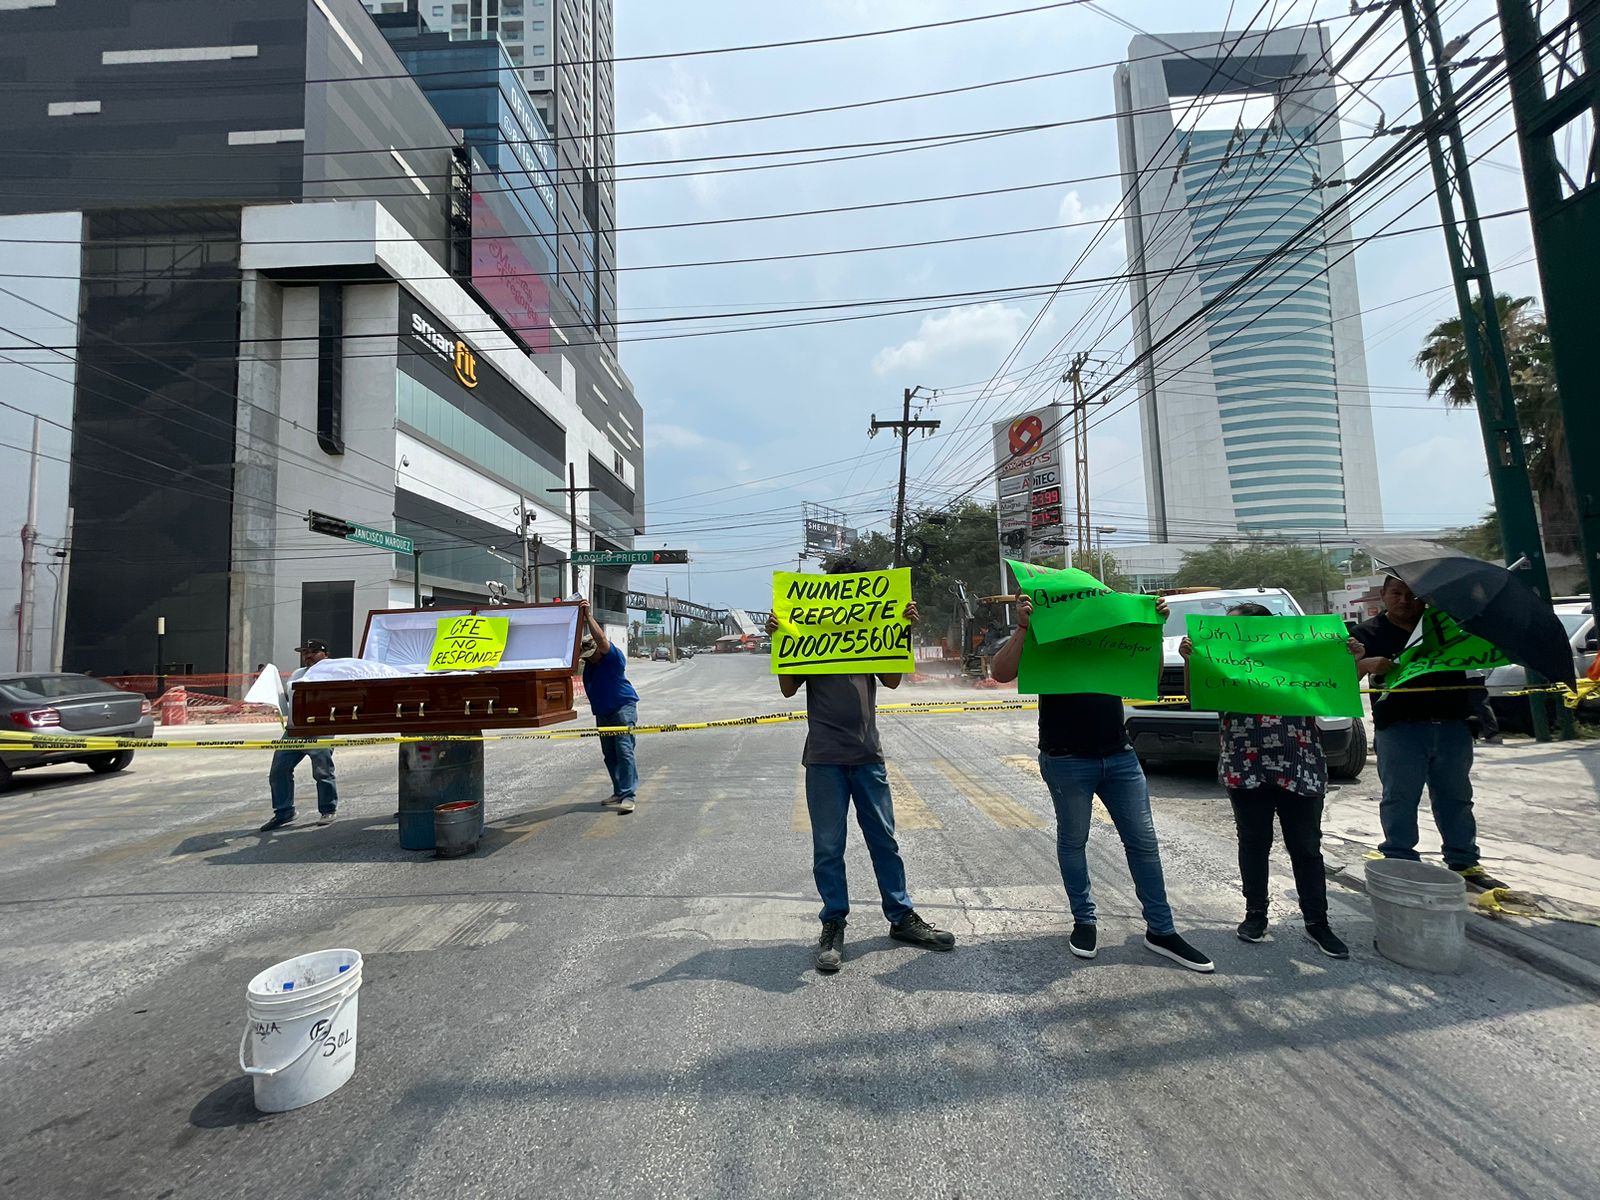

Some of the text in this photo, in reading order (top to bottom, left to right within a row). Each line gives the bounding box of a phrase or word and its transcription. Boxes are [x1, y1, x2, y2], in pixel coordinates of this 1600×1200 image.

[412, 313, 455, 361] smart
[455, 340, 477, 384] fit
[808, 521, 828, 532] SHEIN
[385, 535, 411, 551] MARQUEZ
[577, 553, 648, 562] ADOLFO PRIETO
[786, 575, 890, 601] NUMERO
[788, 599, 898, 626] REPORTE
[450, 618, 486, 636] CFE
[1278, 630, 1305, 642] no
[450, 639, 477, 650] NO
[432, 650, 502, 666] RESPONDE
[1205, 645, 1265, 673] trabajo
